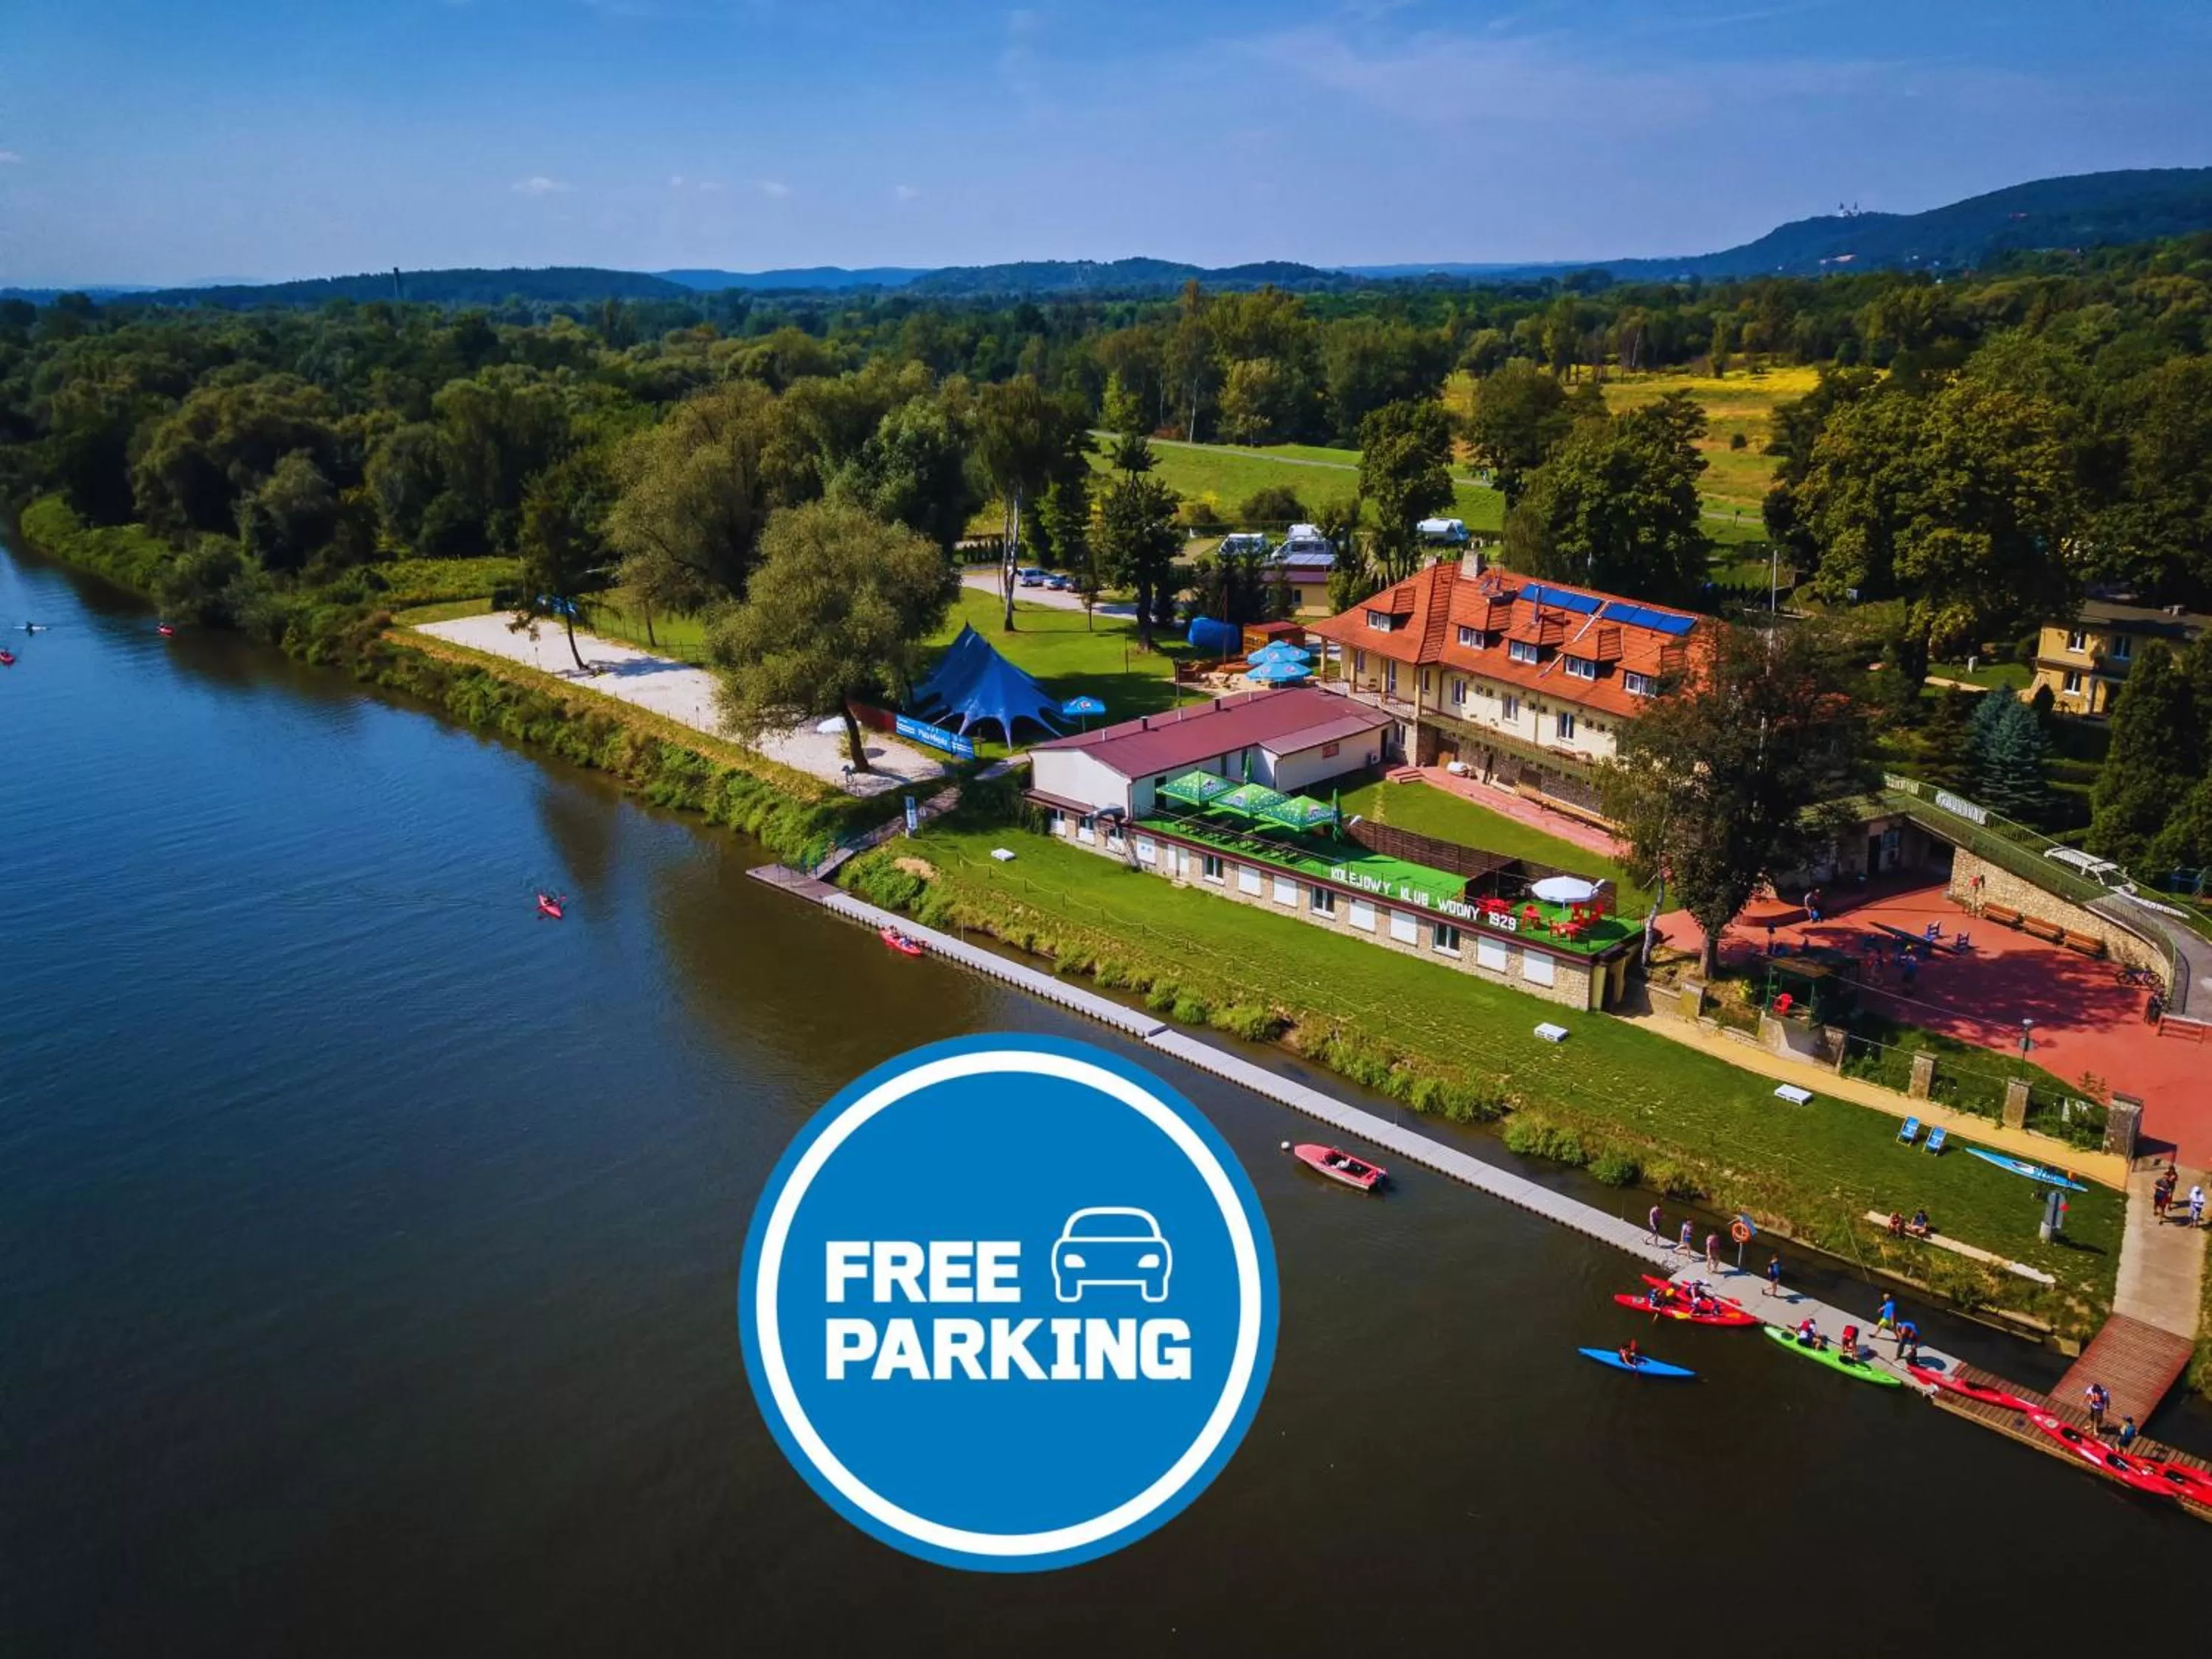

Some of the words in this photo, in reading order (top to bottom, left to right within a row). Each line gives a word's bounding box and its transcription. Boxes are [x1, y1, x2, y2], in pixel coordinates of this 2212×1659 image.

[1331, 866, 1391, 894] KOLEJOWY
[1400, 886, 1428, 908] KLUB
[1438, 897, 1480, 921] WODNY
[1488, 911, 1517, 931] 1929
